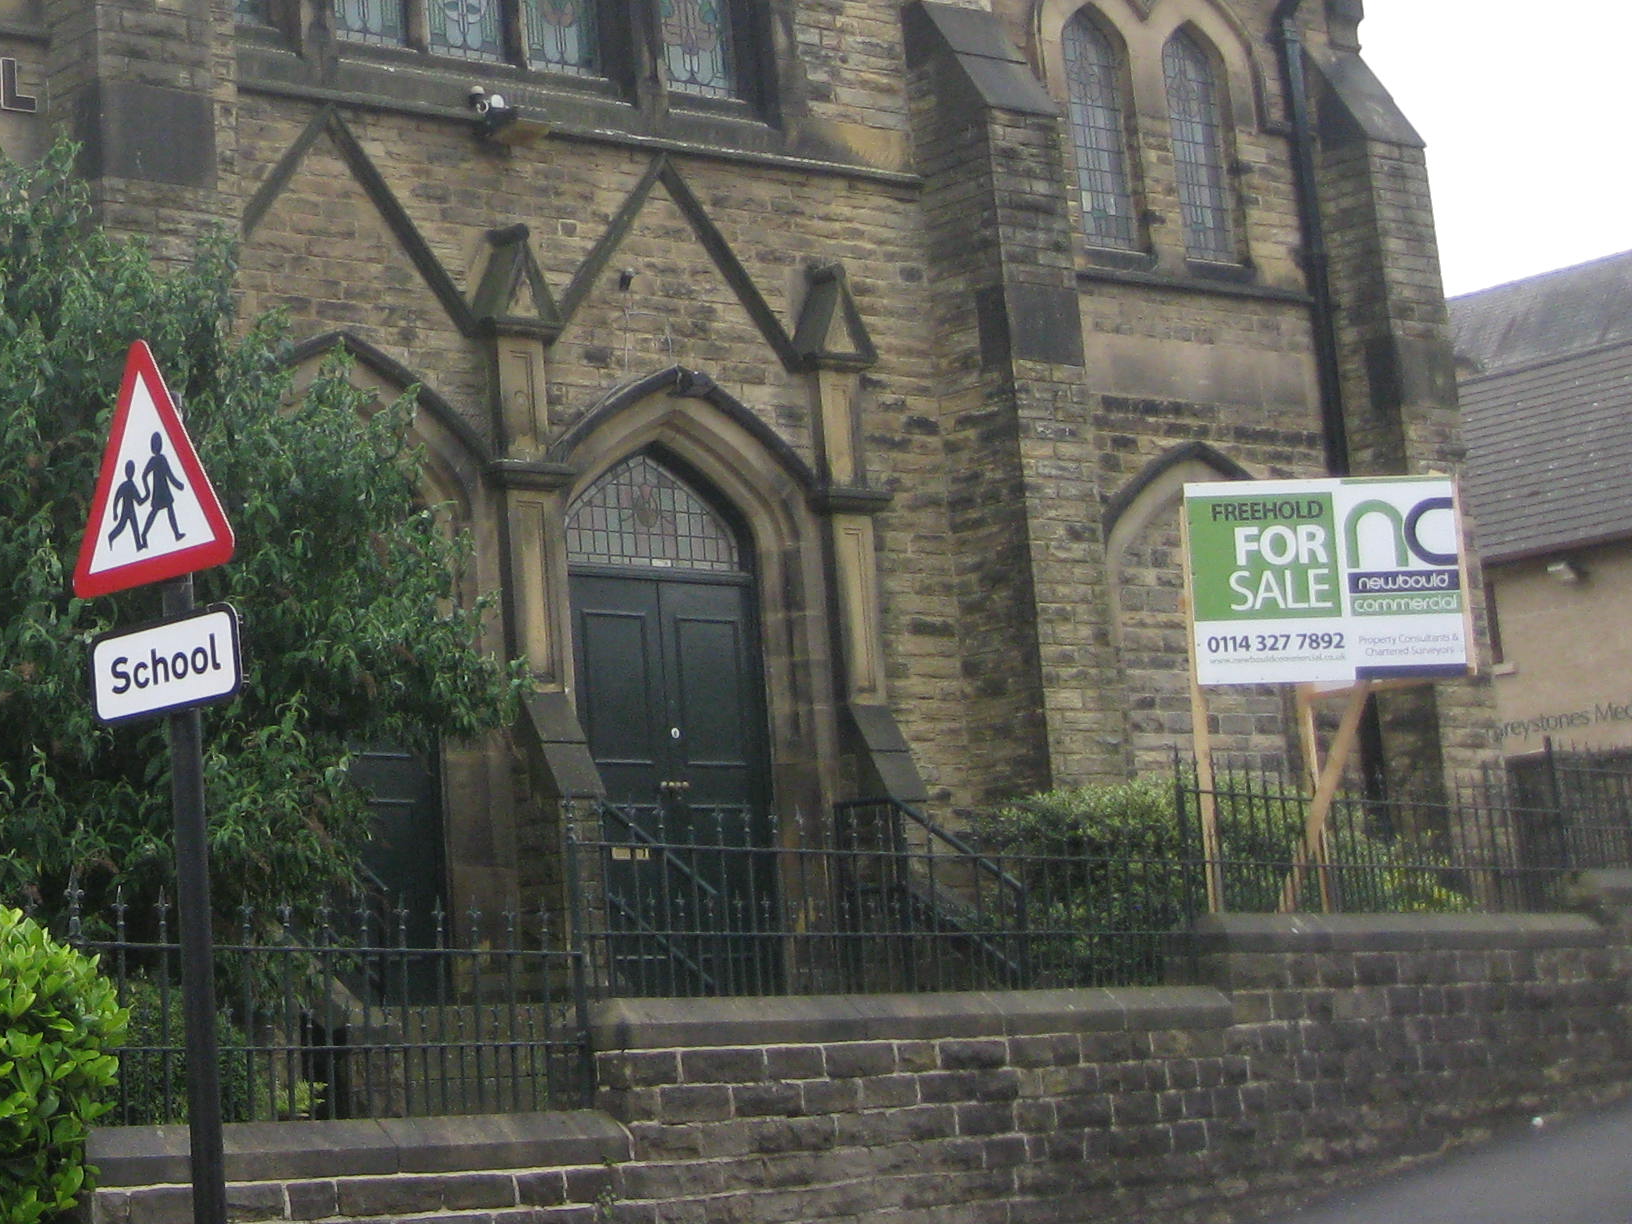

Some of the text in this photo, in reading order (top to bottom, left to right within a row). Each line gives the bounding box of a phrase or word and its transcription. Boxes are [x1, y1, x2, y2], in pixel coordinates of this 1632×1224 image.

[1211, 500, 1323, 522] FREEHOLD
[1234, 525, 1329, 566] FOR
[1229, 568, 1333, 611] SALE
[1357, 573, 1449, 591] newbould
[1354, 593, 1458, 613] commercial
[1207, 632, 1345, 653] 0114 327 7892
[1358, 635, 1396, 646] Property
[111, 633, 221, 695] School
